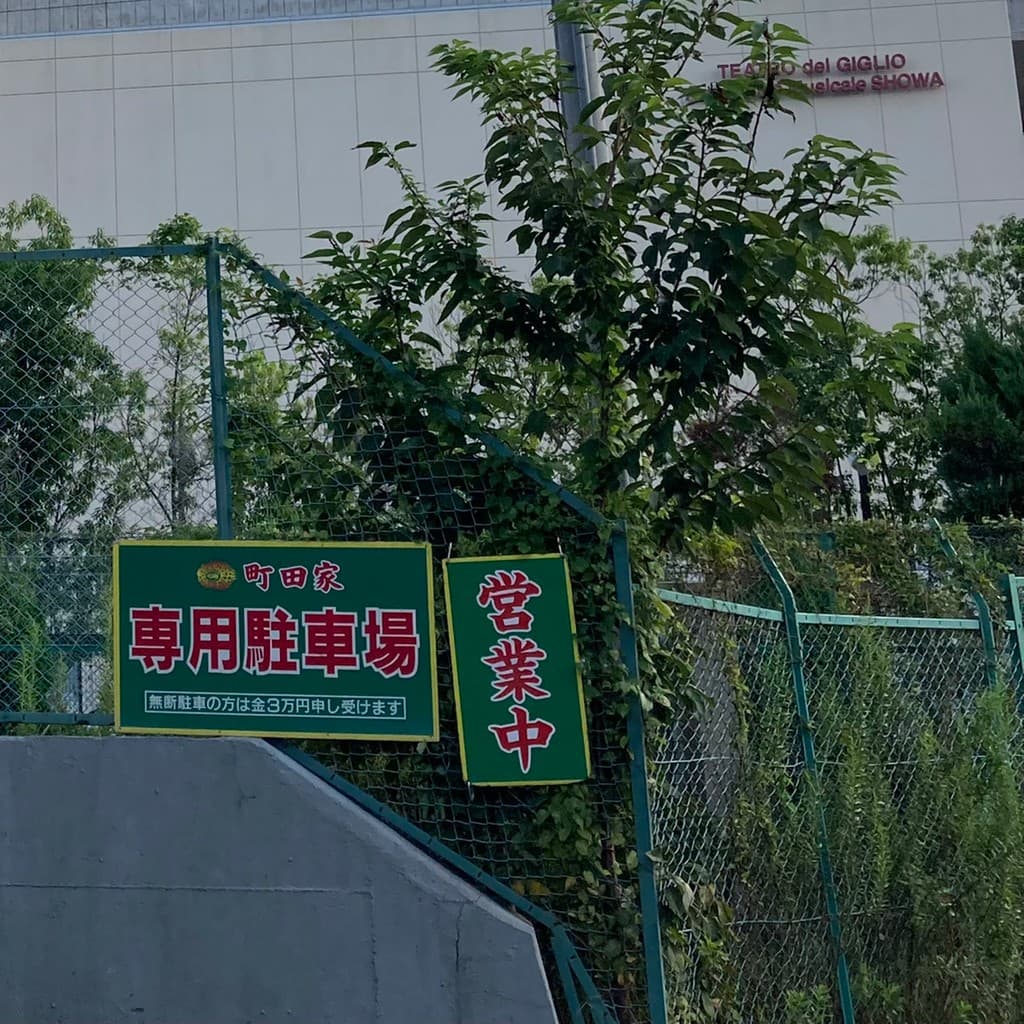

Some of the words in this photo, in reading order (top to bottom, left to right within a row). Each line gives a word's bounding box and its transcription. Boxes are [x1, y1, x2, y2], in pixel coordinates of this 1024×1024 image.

[802, 57, 830, 76] del
[836, 53, 906, 73] GIGLIO
[871, 71, 944, 91] SHOWA
[243, 560, 344, 593] 町田家
[129, 604, 419, 678] 専用駐車場
[477, 569, 556, 774] 営業中
[148, 694, 402, 716] 無断駐車の方は金3万円申し受けます
